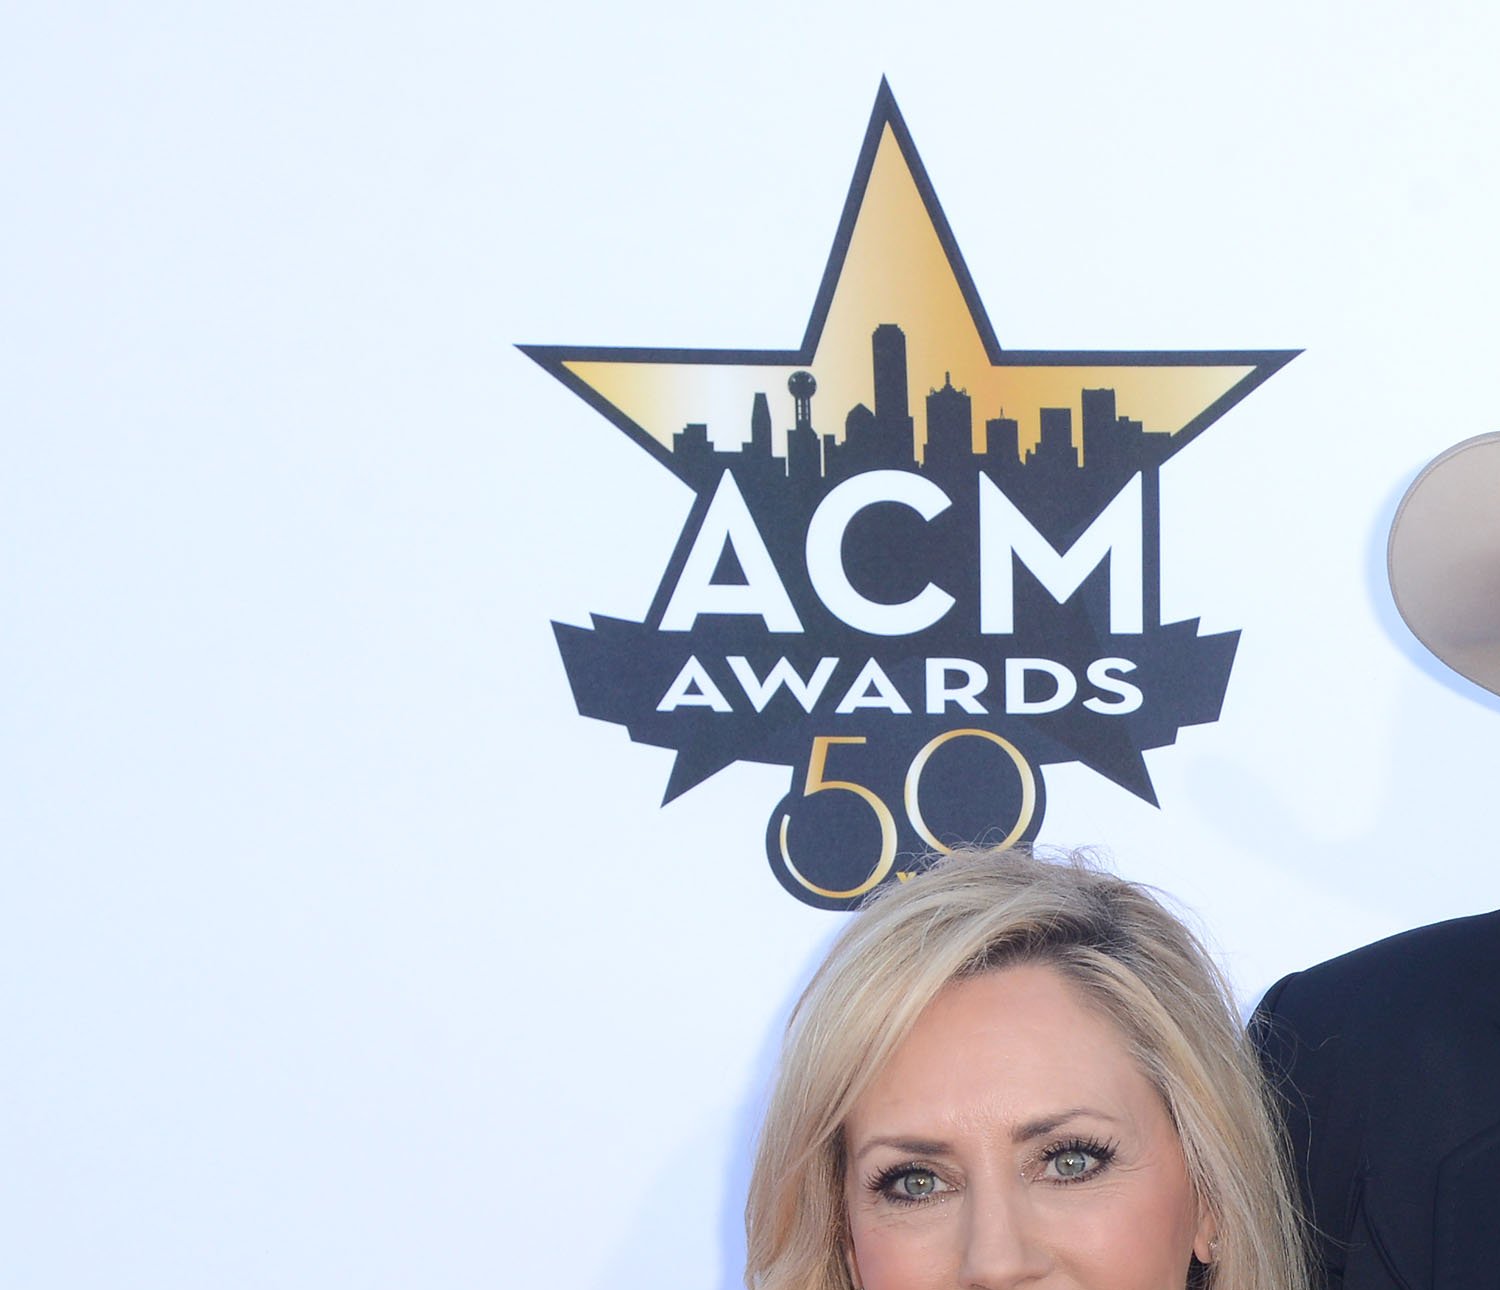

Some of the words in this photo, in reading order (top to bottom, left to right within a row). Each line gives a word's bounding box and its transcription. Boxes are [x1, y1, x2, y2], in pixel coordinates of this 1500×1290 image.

[658, 468, 1144, 636] ACM
[655, 655, 1144, 715] AWARDS
[779, 728, 1036, 898] 50
